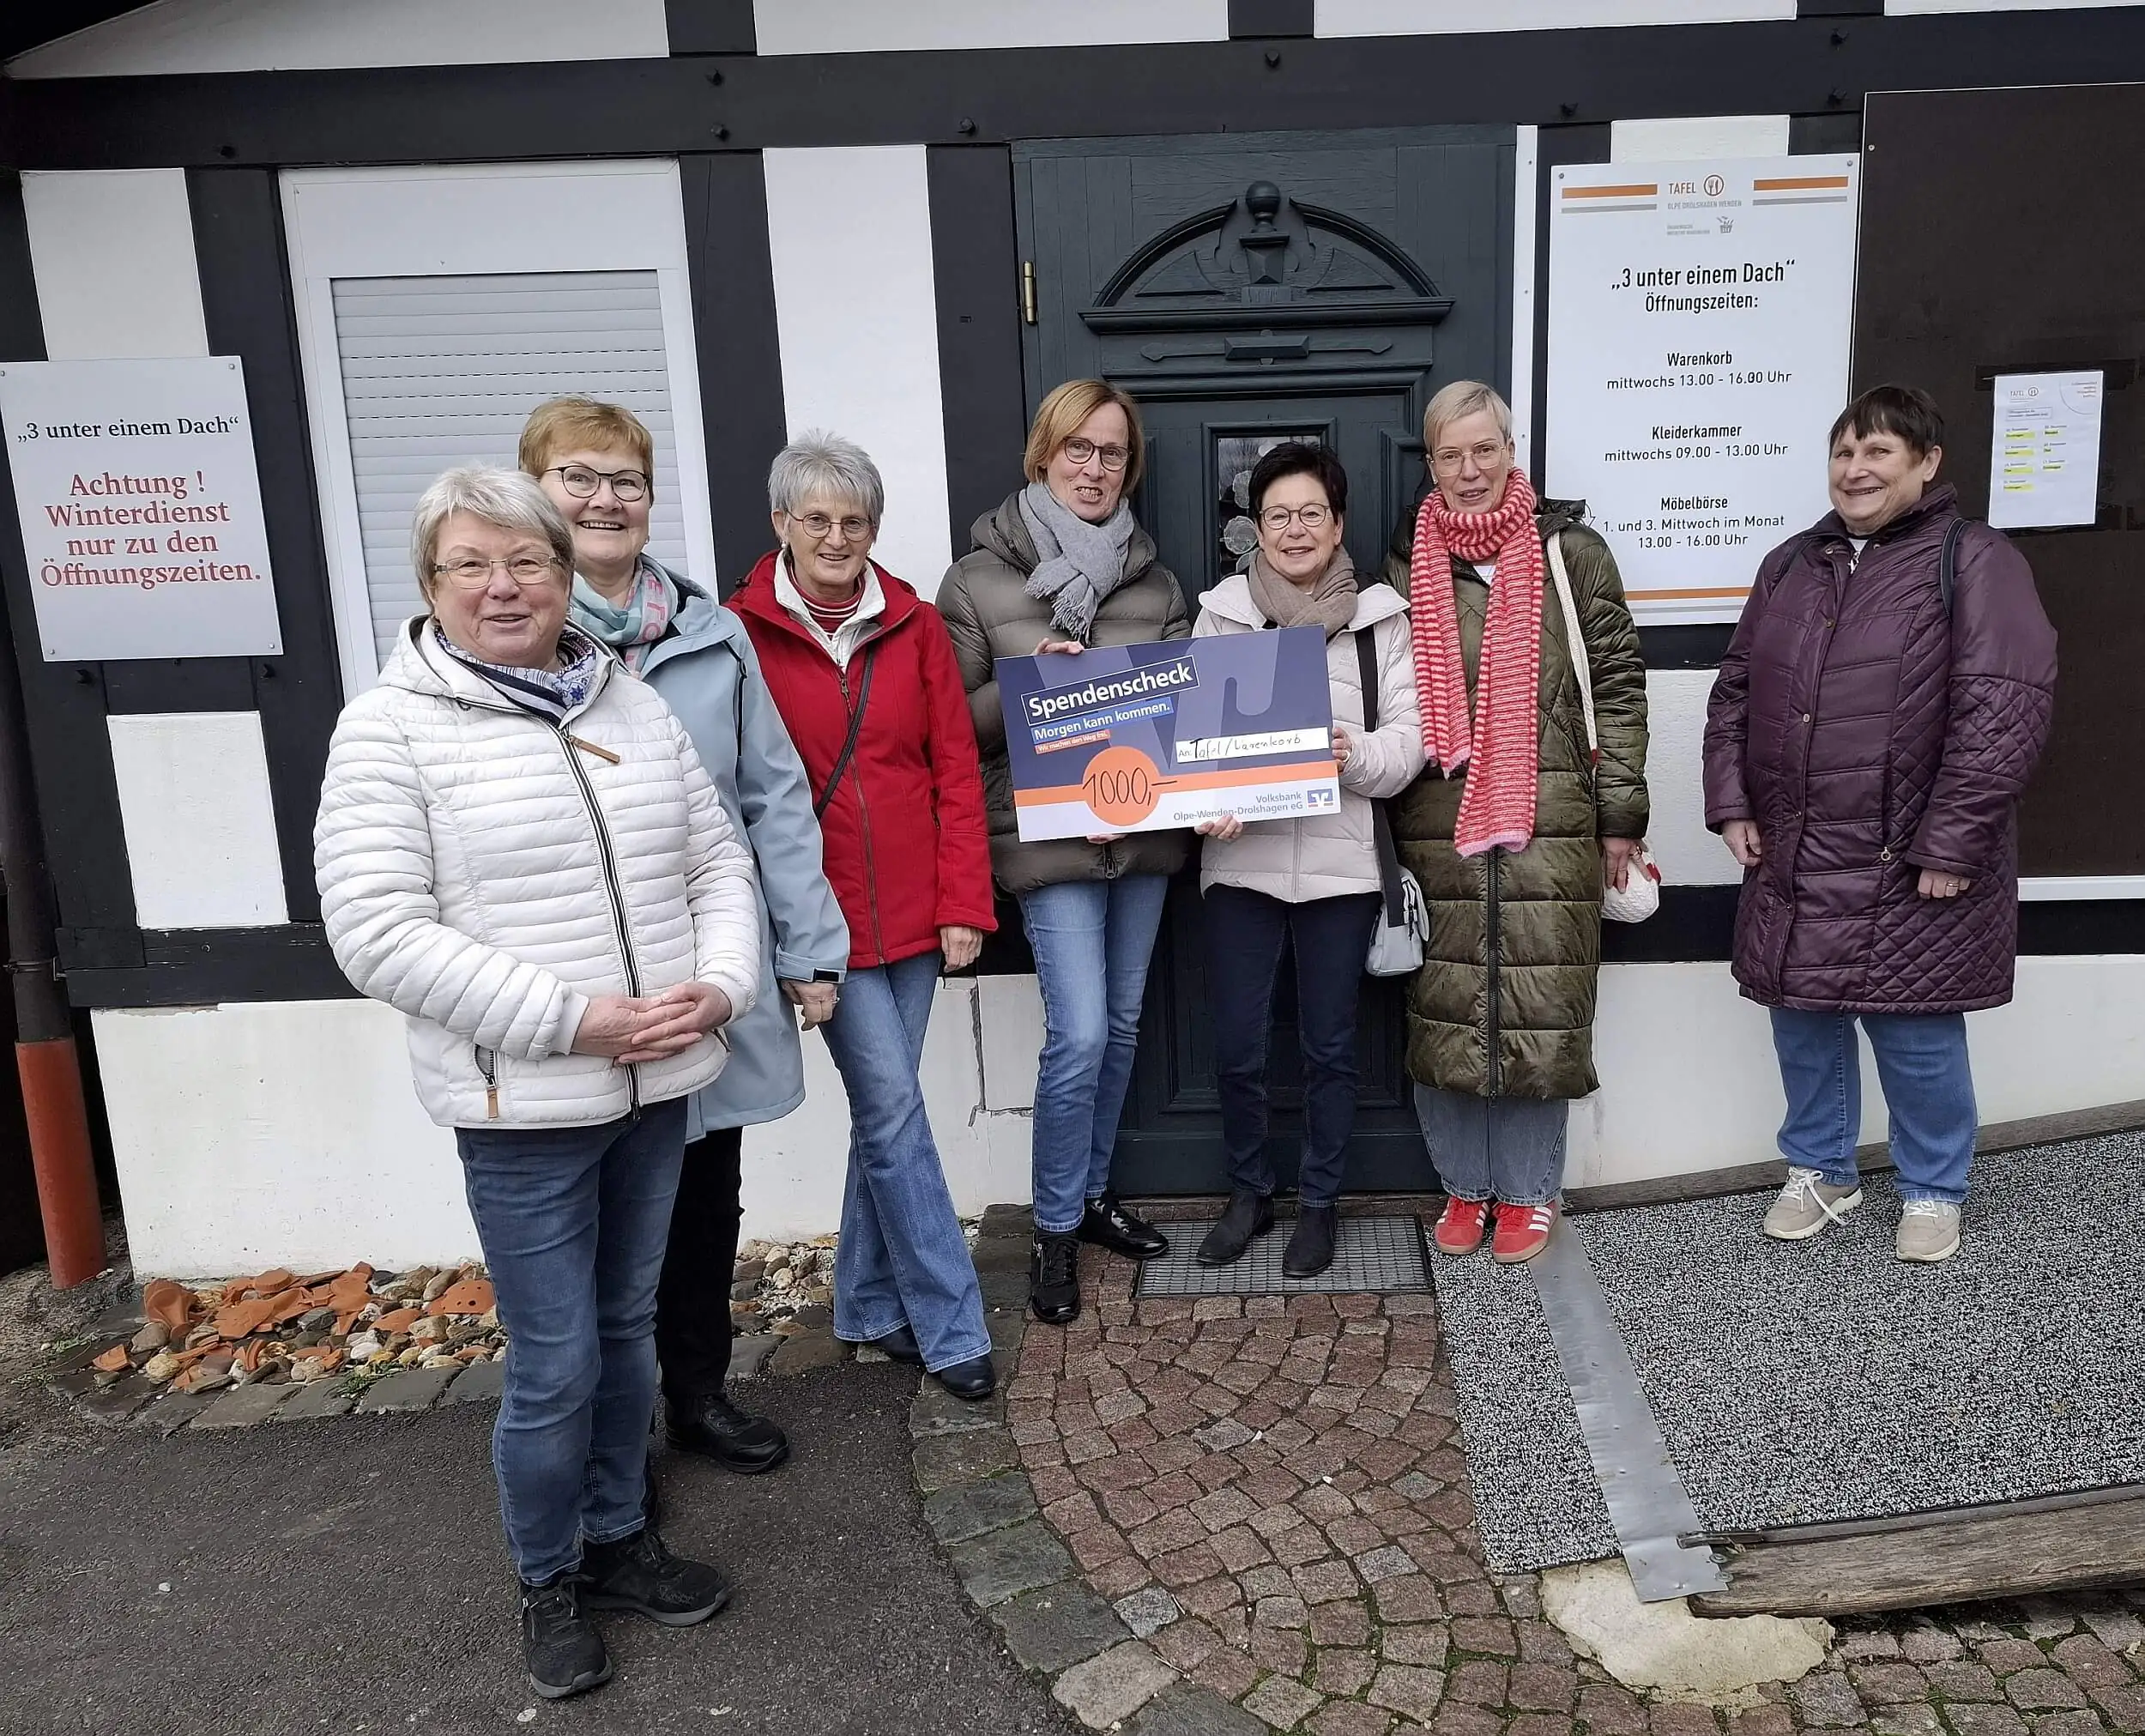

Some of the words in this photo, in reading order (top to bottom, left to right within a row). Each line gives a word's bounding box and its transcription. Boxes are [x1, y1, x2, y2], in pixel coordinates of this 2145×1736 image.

[1669, 182, 1696, 195] TAFEL
[1637, 268, 1682, 287] unter
[1687, 264, 1737, 285] einem
[1646, 293, 1759, 314] Öffnungszeiten:
[1667, 350, 1733, 366] Warenkorb
[1606, 375, 1675, 390] mittwochs
[1679, 373, 1714, 386] 13.00
[1767, 371, 1792, 383] Uhr
[45, 421, 101, 439] unter
[108, 418, 172, 437] einem
[1652, 425, 1743, 440] Kleiderkammer
[1604, 448, 1672, 462] mittwochs
[1676, 446, 1711, 460] 09.00
[1725, 445, 1760, 457] 13.00
[1763, 444, 1789, 456] Uhr
[69, 471, 188, 499] Achtung
[45, 499, 231, 527] Winterdienst
[1660, 496, 1729, 511] Möbelbörse
[1603, 520, 1614, 532] 1.
[1618, 520, 1641, 531] und
[1646, 519, 1657, 531] 3.
[1661, 517, 1720, 530] Mittwoch
[1724, 516, 1740, 528] im
[1744, 515, 1785, 527] Monat
[66, 538, 116, 556] nur
[124, 536, 159, 554] zu
[166, 529, 219, 553] den
[1638, 536, 1672, 549] 13.00
[1687, 535, 1720, 547] 16.00
[1724, 534, 1749, 546] Uhr
[41, 558, 262, 590] Öffnungszeiten.
[1029, 662, 1194, 718] Spendenscheck
[1034, 723, 1082, 741] Morgen
[1084, 714, 1113, 730] kann
[1115, 702, 1170, 723] kommen.
[1255, 791, 1302, 803] Volksbank
[1290, 801, 1303, 810] eG
